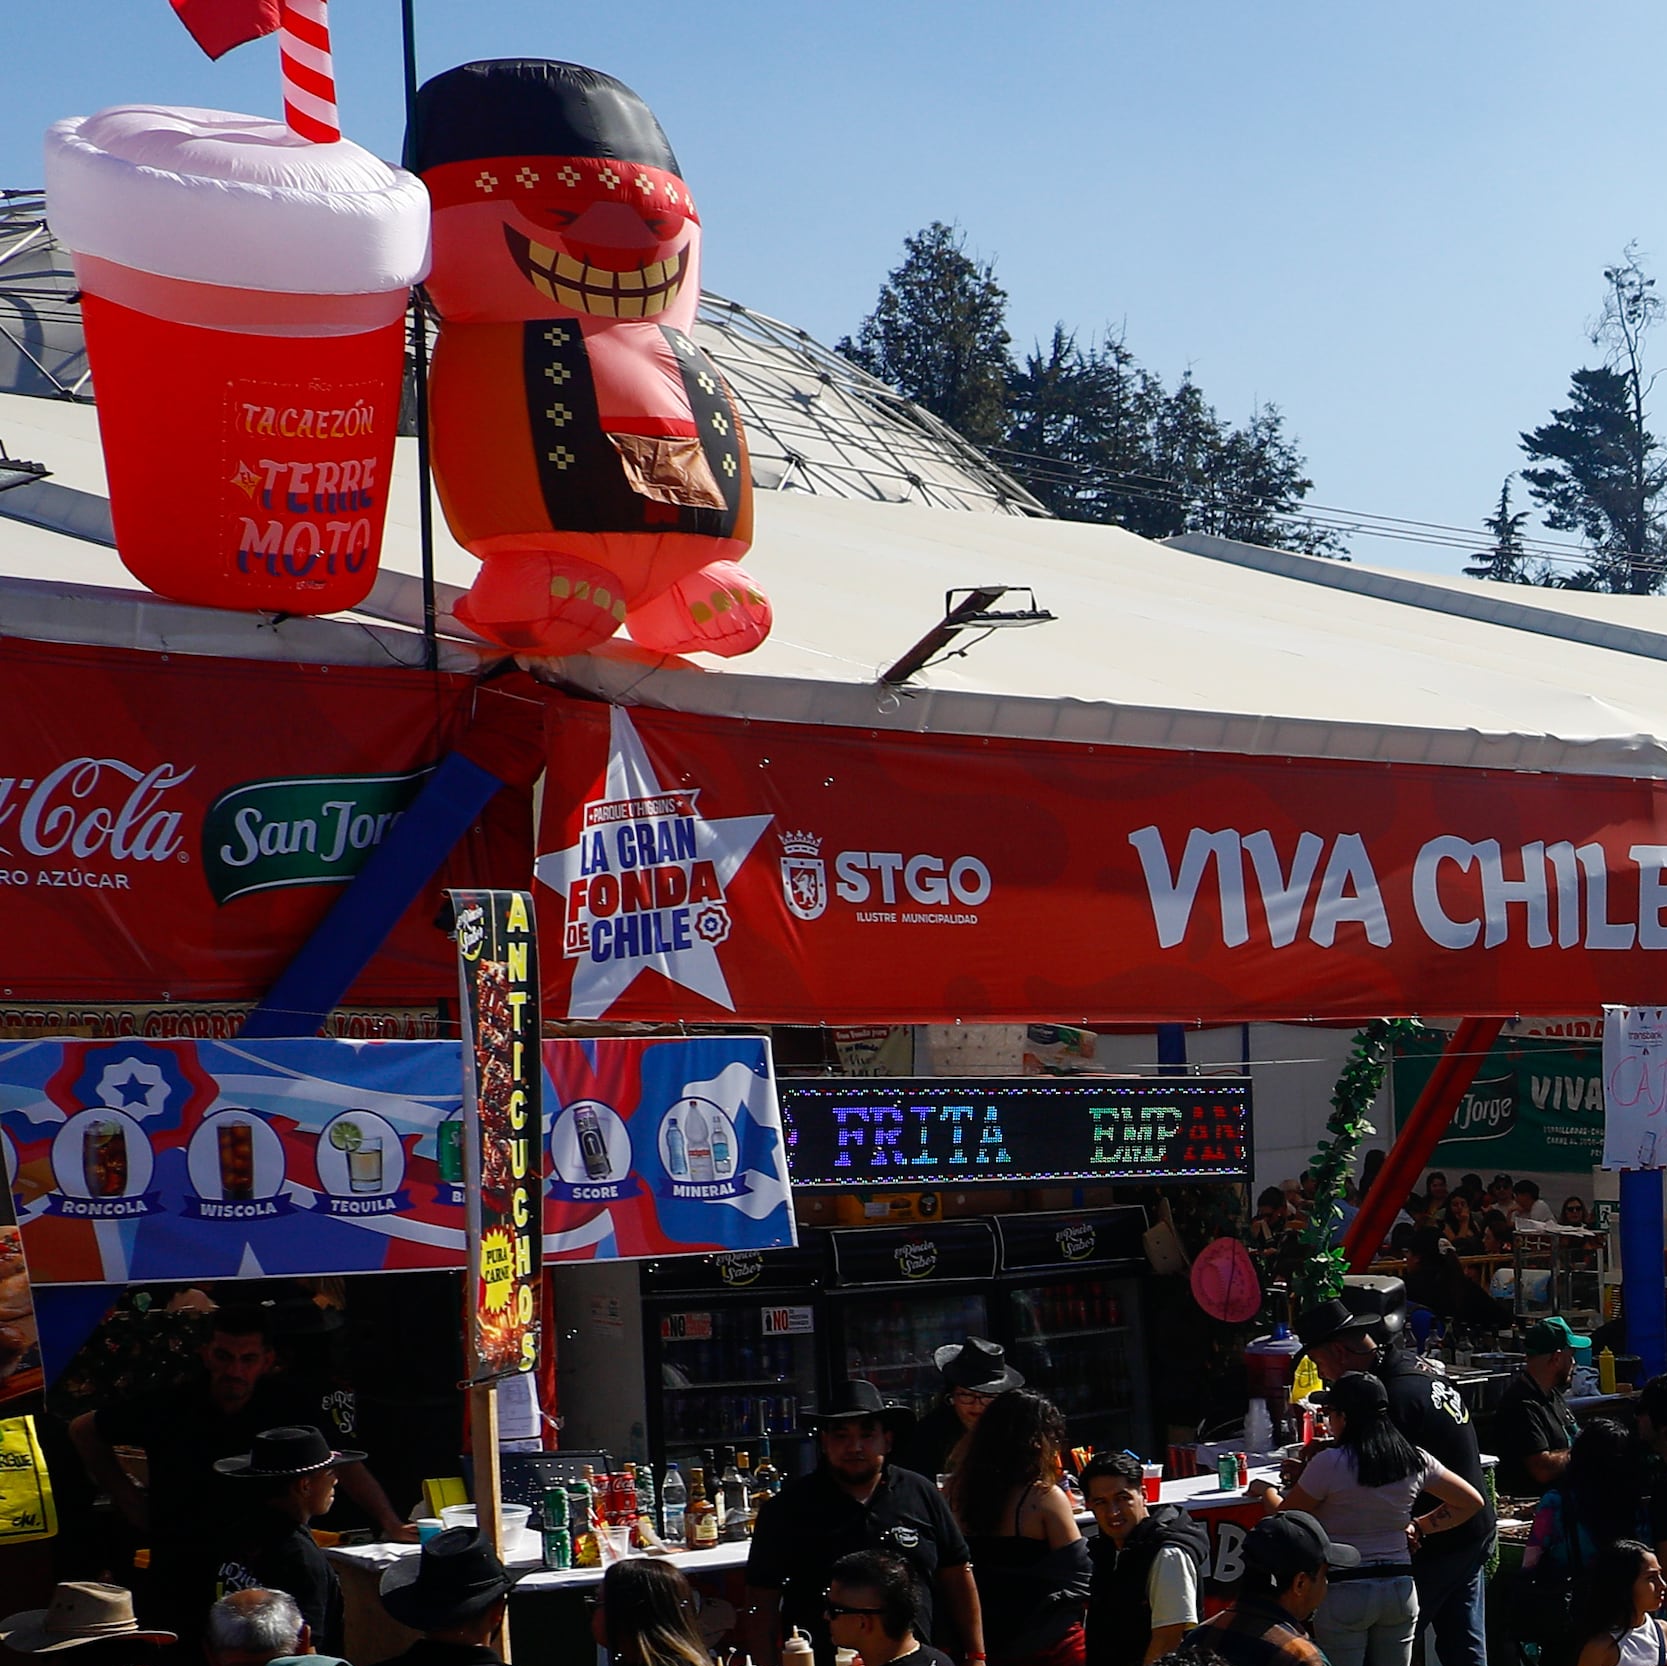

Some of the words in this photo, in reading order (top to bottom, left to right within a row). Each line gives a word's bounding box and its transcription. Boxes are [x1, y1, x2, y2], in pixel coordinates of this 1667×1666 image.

[258, 457, 377, 514] TERRE
[237, 517, 372, 577] MOTO
[592, 802, 627, 823] PARQUE
[220, 806, 317, 867] San
[580, 831, 612, 877] LA
[616, 816, 698, 867] GRAN
[37, 867, 131, 890] AZÚCAR
[567, 860, 723, 923] FONDA
[835, 850, 993, 907] STGO
[1127, 824, 1393, 950] VIVA
[567, 921, 591, 949] DE
[590, 907, 693, 963] CHILE
[856, 911, 897, 923] ILUSTRE
[901, 913, 979, 925] MUNICIPALIDAD
[1530, 1075, 1604, 1112] VIVA
[1458, 1094, 1513, 1130] Jorge
[507, 892, 538, 1372] ANTICUCHOS
[832, 1105, 1012, 1167] FRITA
[61, 1200, 149, 1217] RONCOLA
[330, 1198, 397, 1214] TEQUILA
[572, 1185, 619, 1199] SCORE
[672, 1183, 736, 1198] MINERAL
[200, 1202, 278, 1217] WISCOLA
[485, 1246, 509, 1265] PURA
[773, 1309, 789, 1331] NO
